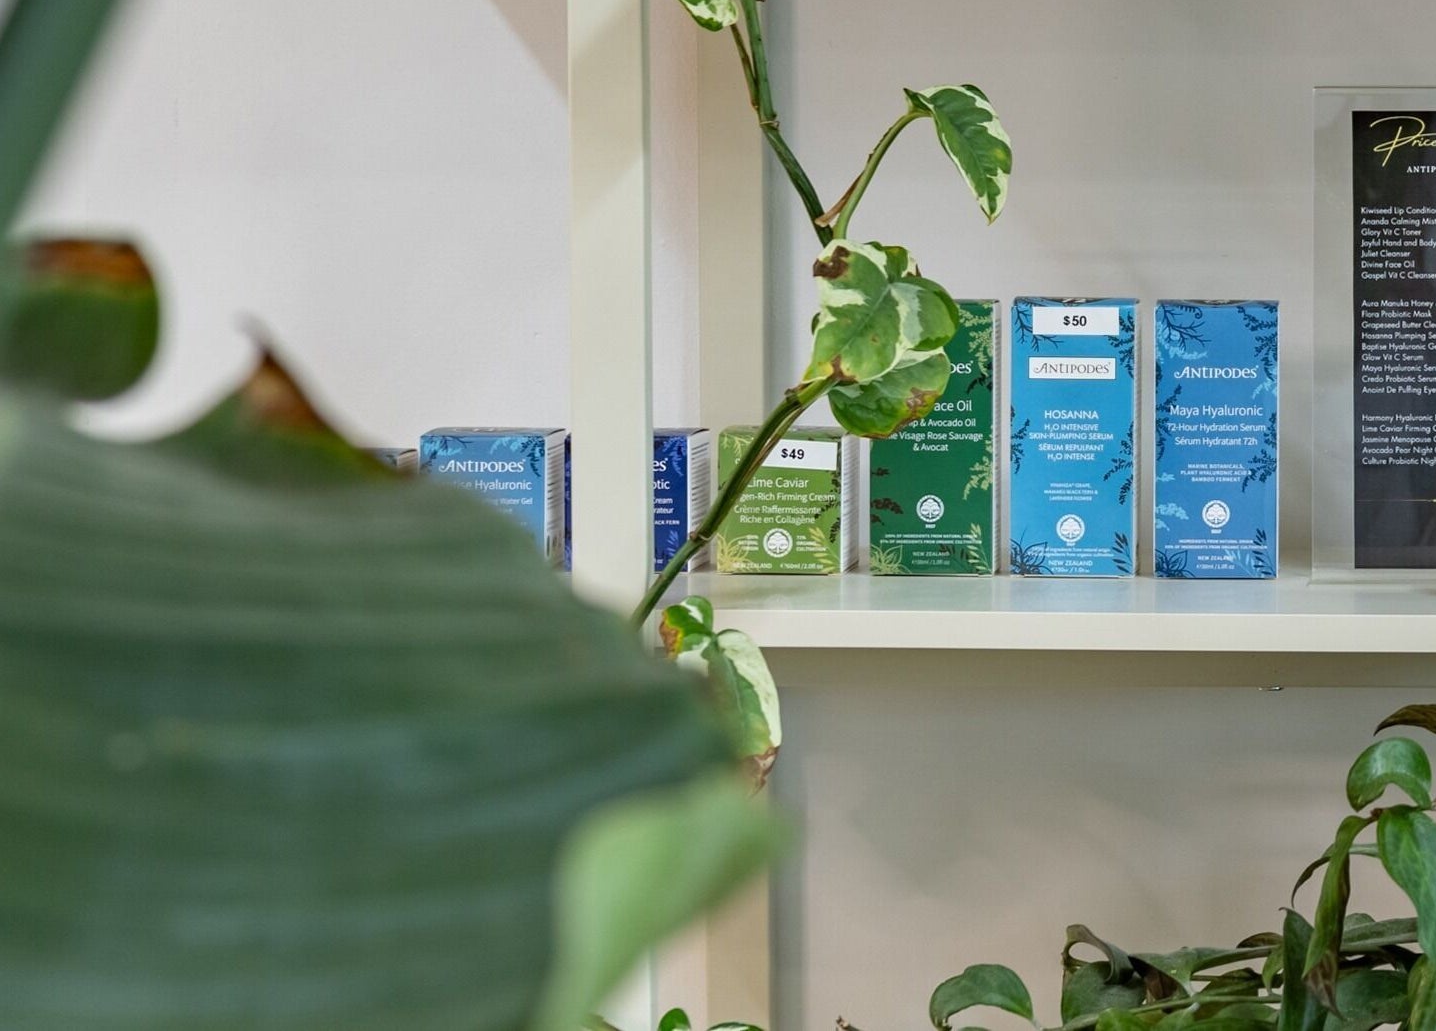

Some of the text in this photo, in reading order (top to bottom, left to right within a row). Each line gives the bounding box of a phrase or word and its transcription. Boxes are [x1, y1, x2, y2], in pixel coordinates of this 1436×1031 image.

[1361, 206, 1393, 214] Kiwiseed
[1394, 207, 1405, 216] Lip
[1361, 217, 1389, 225] Ananda
[1391, 217, 1420, 227] Calming
[1361, 228, 1381, 238] Glory
[1383, 228, 1393, 236] Vit
[1394, 228, 1400, 236] C
[1402, 228, 1422, 236] Toner
[1361, 239, 1381, 248] Joyful
[1403, 238, 1418, 247] and
[1419, 239, 1436, 249] Body
[1361, 250, 1379, 258] Juliet
[1380, 250, 1411, 258] Cleanser
[1385, 260, 1402, 268] Face
[1403, 260, 1415, 268] Oil
[1361, 271, 1387, 281] Gospel
[1399, 271, 1406, 279] C
[1063, 316, 1087, 327] $50
[934, 400, 972, 412] ace Oil
[1044, 410, 1099, 419] HOSANNA
[1170, 405, 1263, 419] Maya Hyaluronic
[1061, 423, 1099, 431] INTENSIVE
[1167, 422, 1266, 433] 72-Hour Hydration Serum
[899, 431, 983, 443] Visage Rose Sauvage
[1174, 437, 1257, 447] Sérum Hydratant 72h
[913, 443, 949, 452] & Avocat
[781, 448, 805, 460] $49
[475, 479, 532, 492] Hyaluronic
[776, 477, 809, 488] Caviar
[740, 492, 836, 503] gen-Rich Firming Cream
[734, 504, 821, 514] Crème Raffermissante
